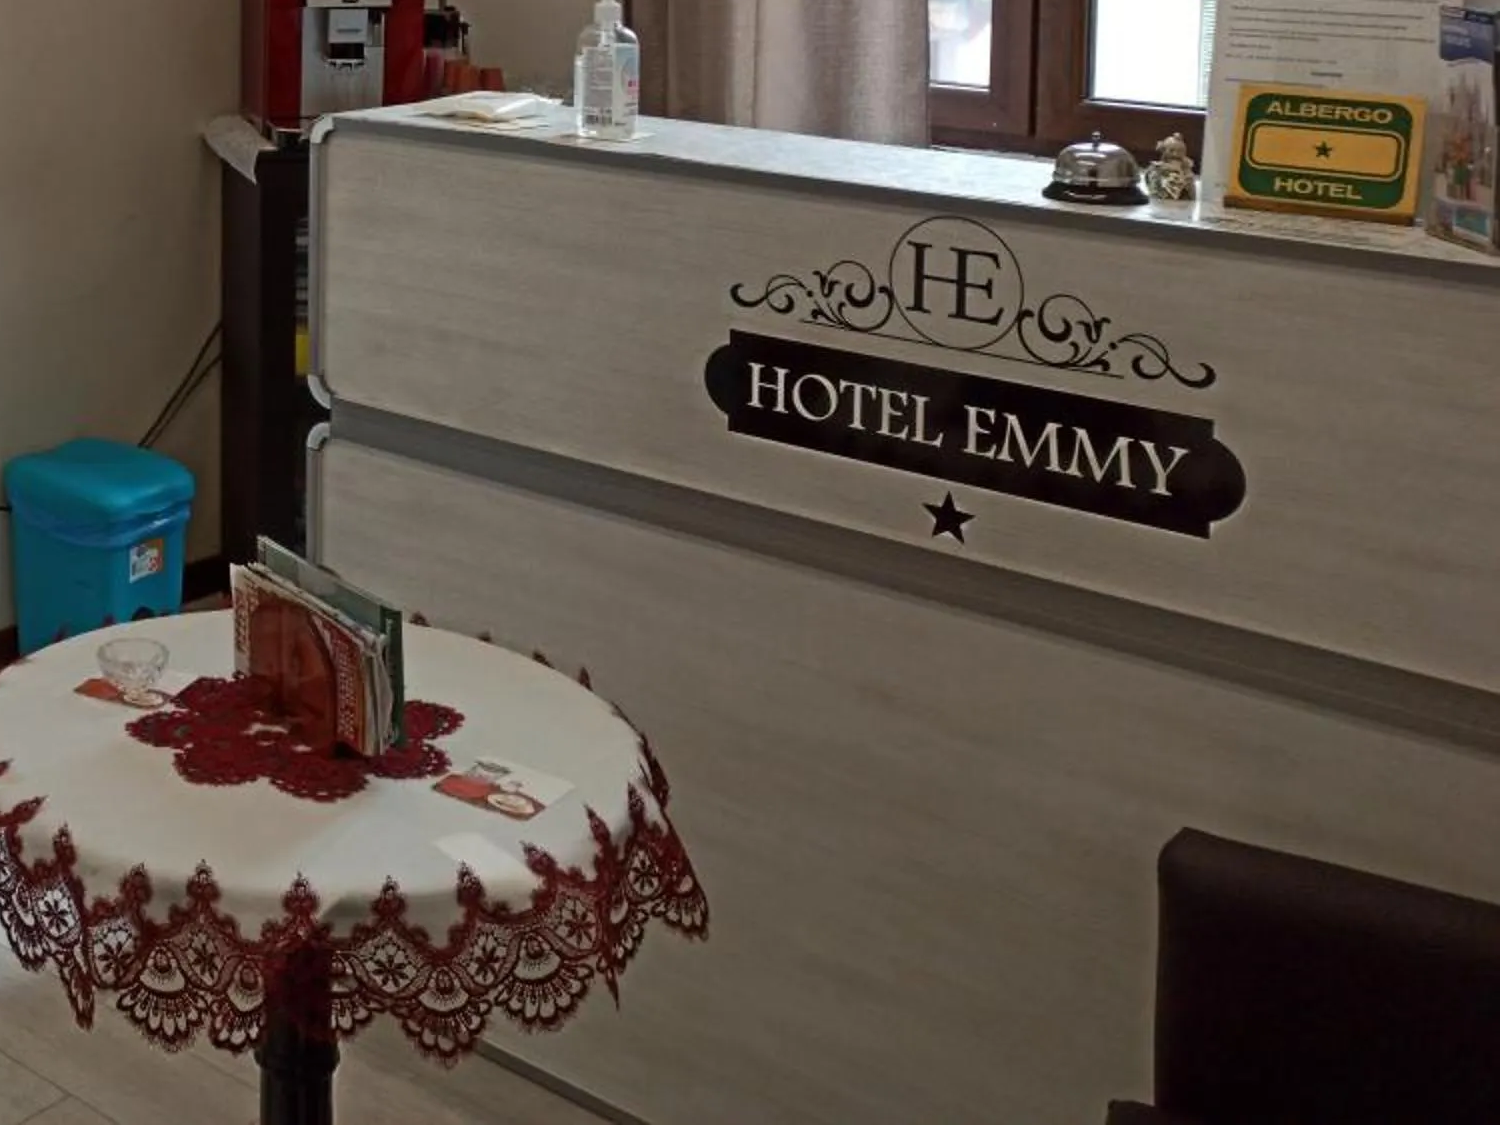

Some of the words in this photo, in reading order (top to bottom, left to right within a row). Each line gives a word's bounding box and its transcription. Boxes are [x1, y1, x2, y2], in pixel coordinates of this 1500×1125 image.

[1264, 100, 1394, 124] ALBERGO
[1273, 177, 1364, 201] HOTEL
[905, 240, 1005, 327] HE
[746, 362, 943, 448] HOTEL
[963, 403, 1190, 497] EMMY
